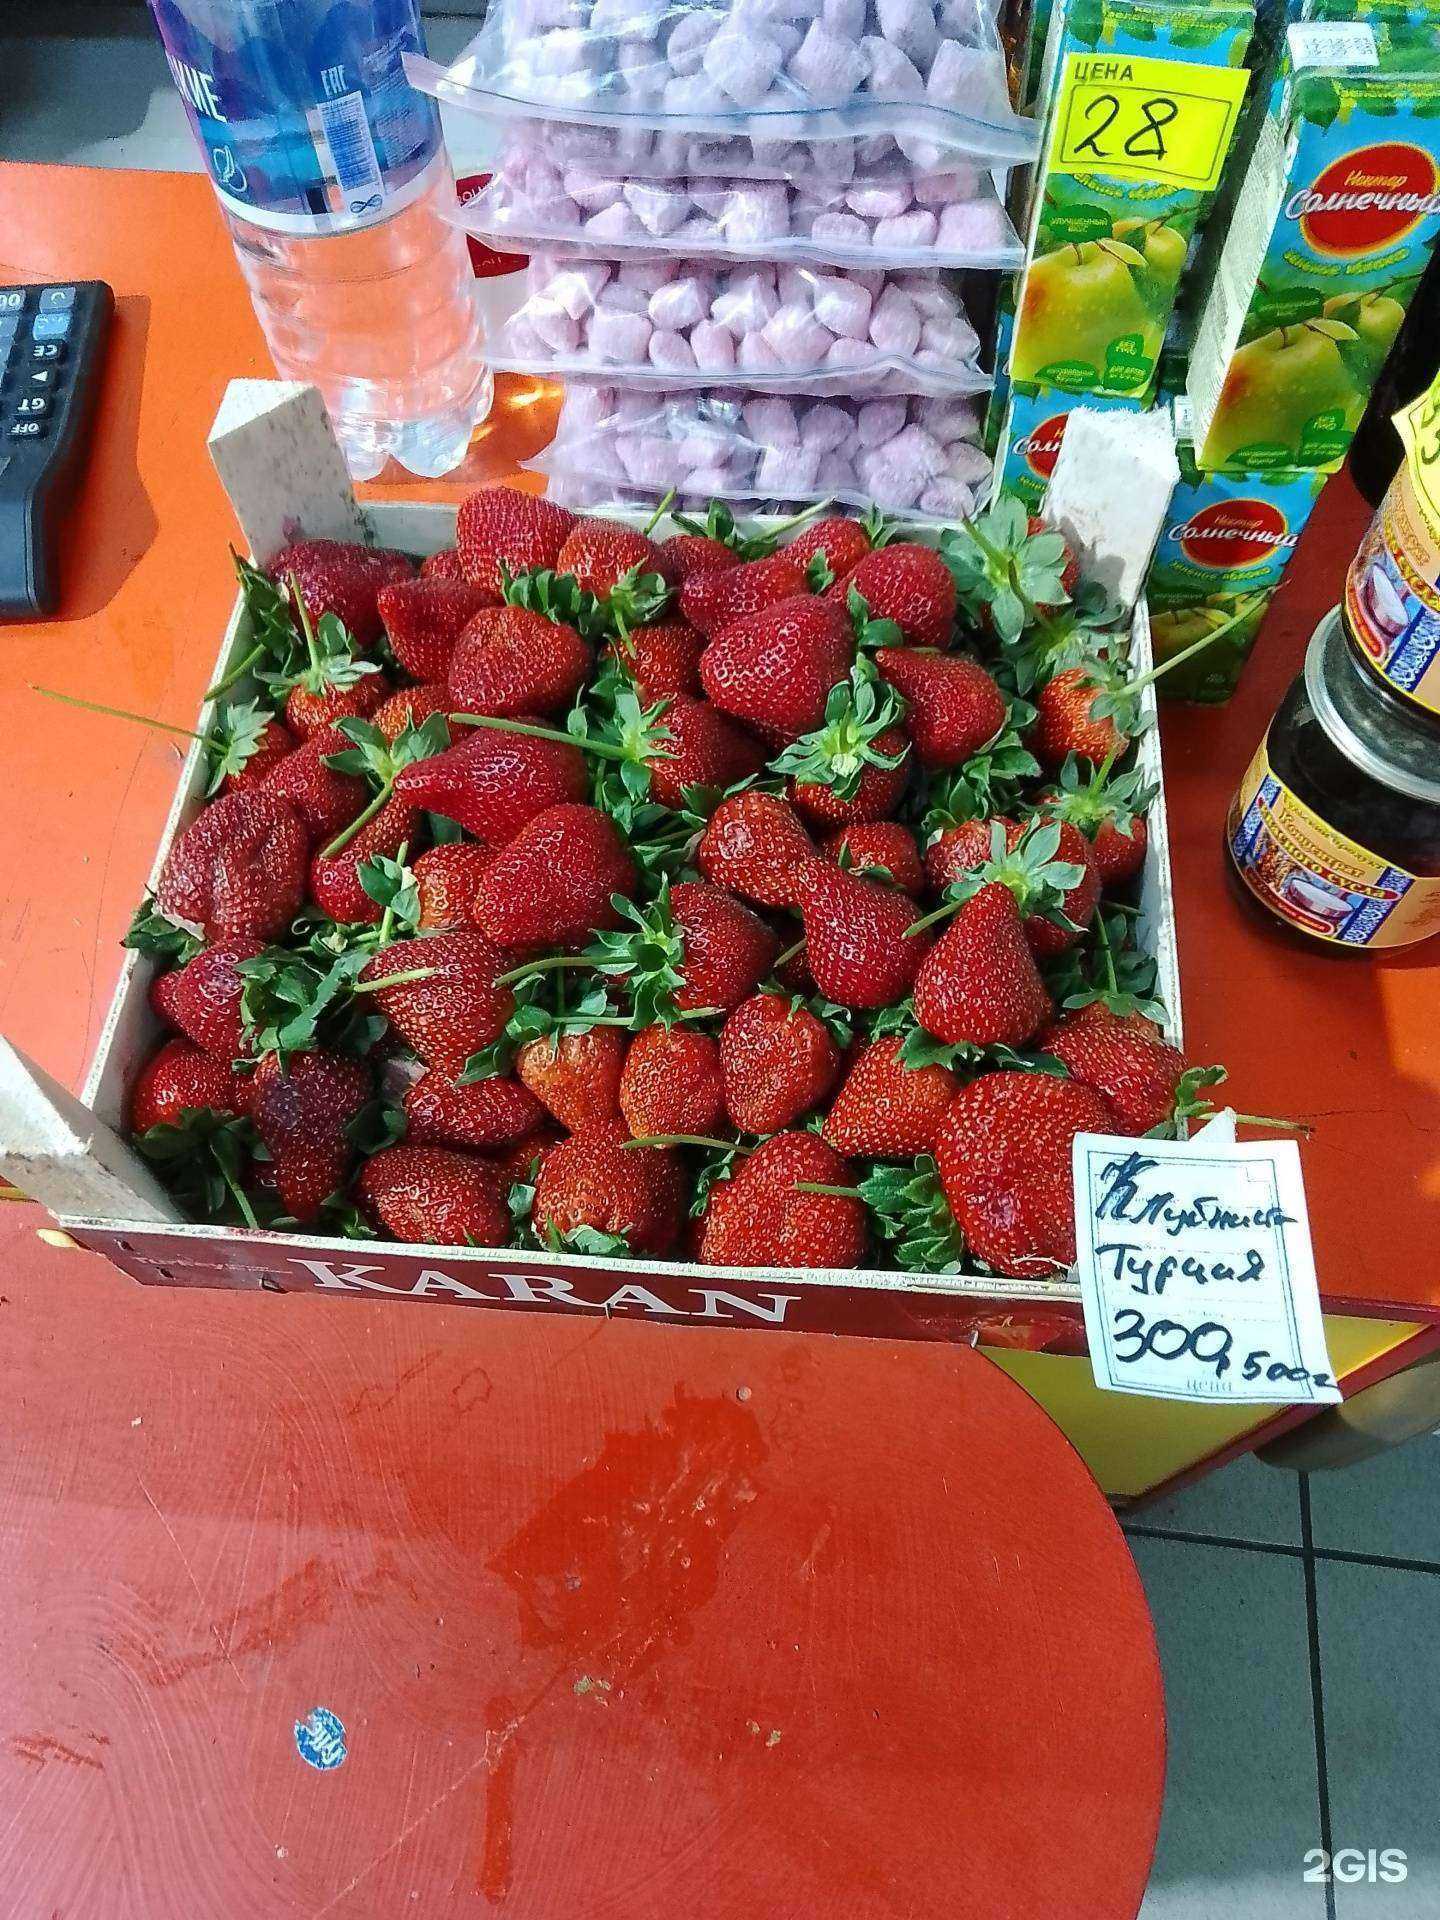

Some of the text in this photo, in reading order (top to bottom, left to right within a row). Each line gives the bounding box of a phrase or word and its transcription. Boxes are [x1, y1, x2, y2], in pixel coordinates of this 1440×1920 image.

[1073, 62, 1134, 84] ЦЕНА
[1073, 94, 1179, 160] 28
[33, 344, 58, 357] CE
[17, 397, 46, 412] GT
[11, 422, 40, 435] OFF
[1094, 1242, 1266, 1295] Турция
[286, 1257, 802, 1323] KARAN
